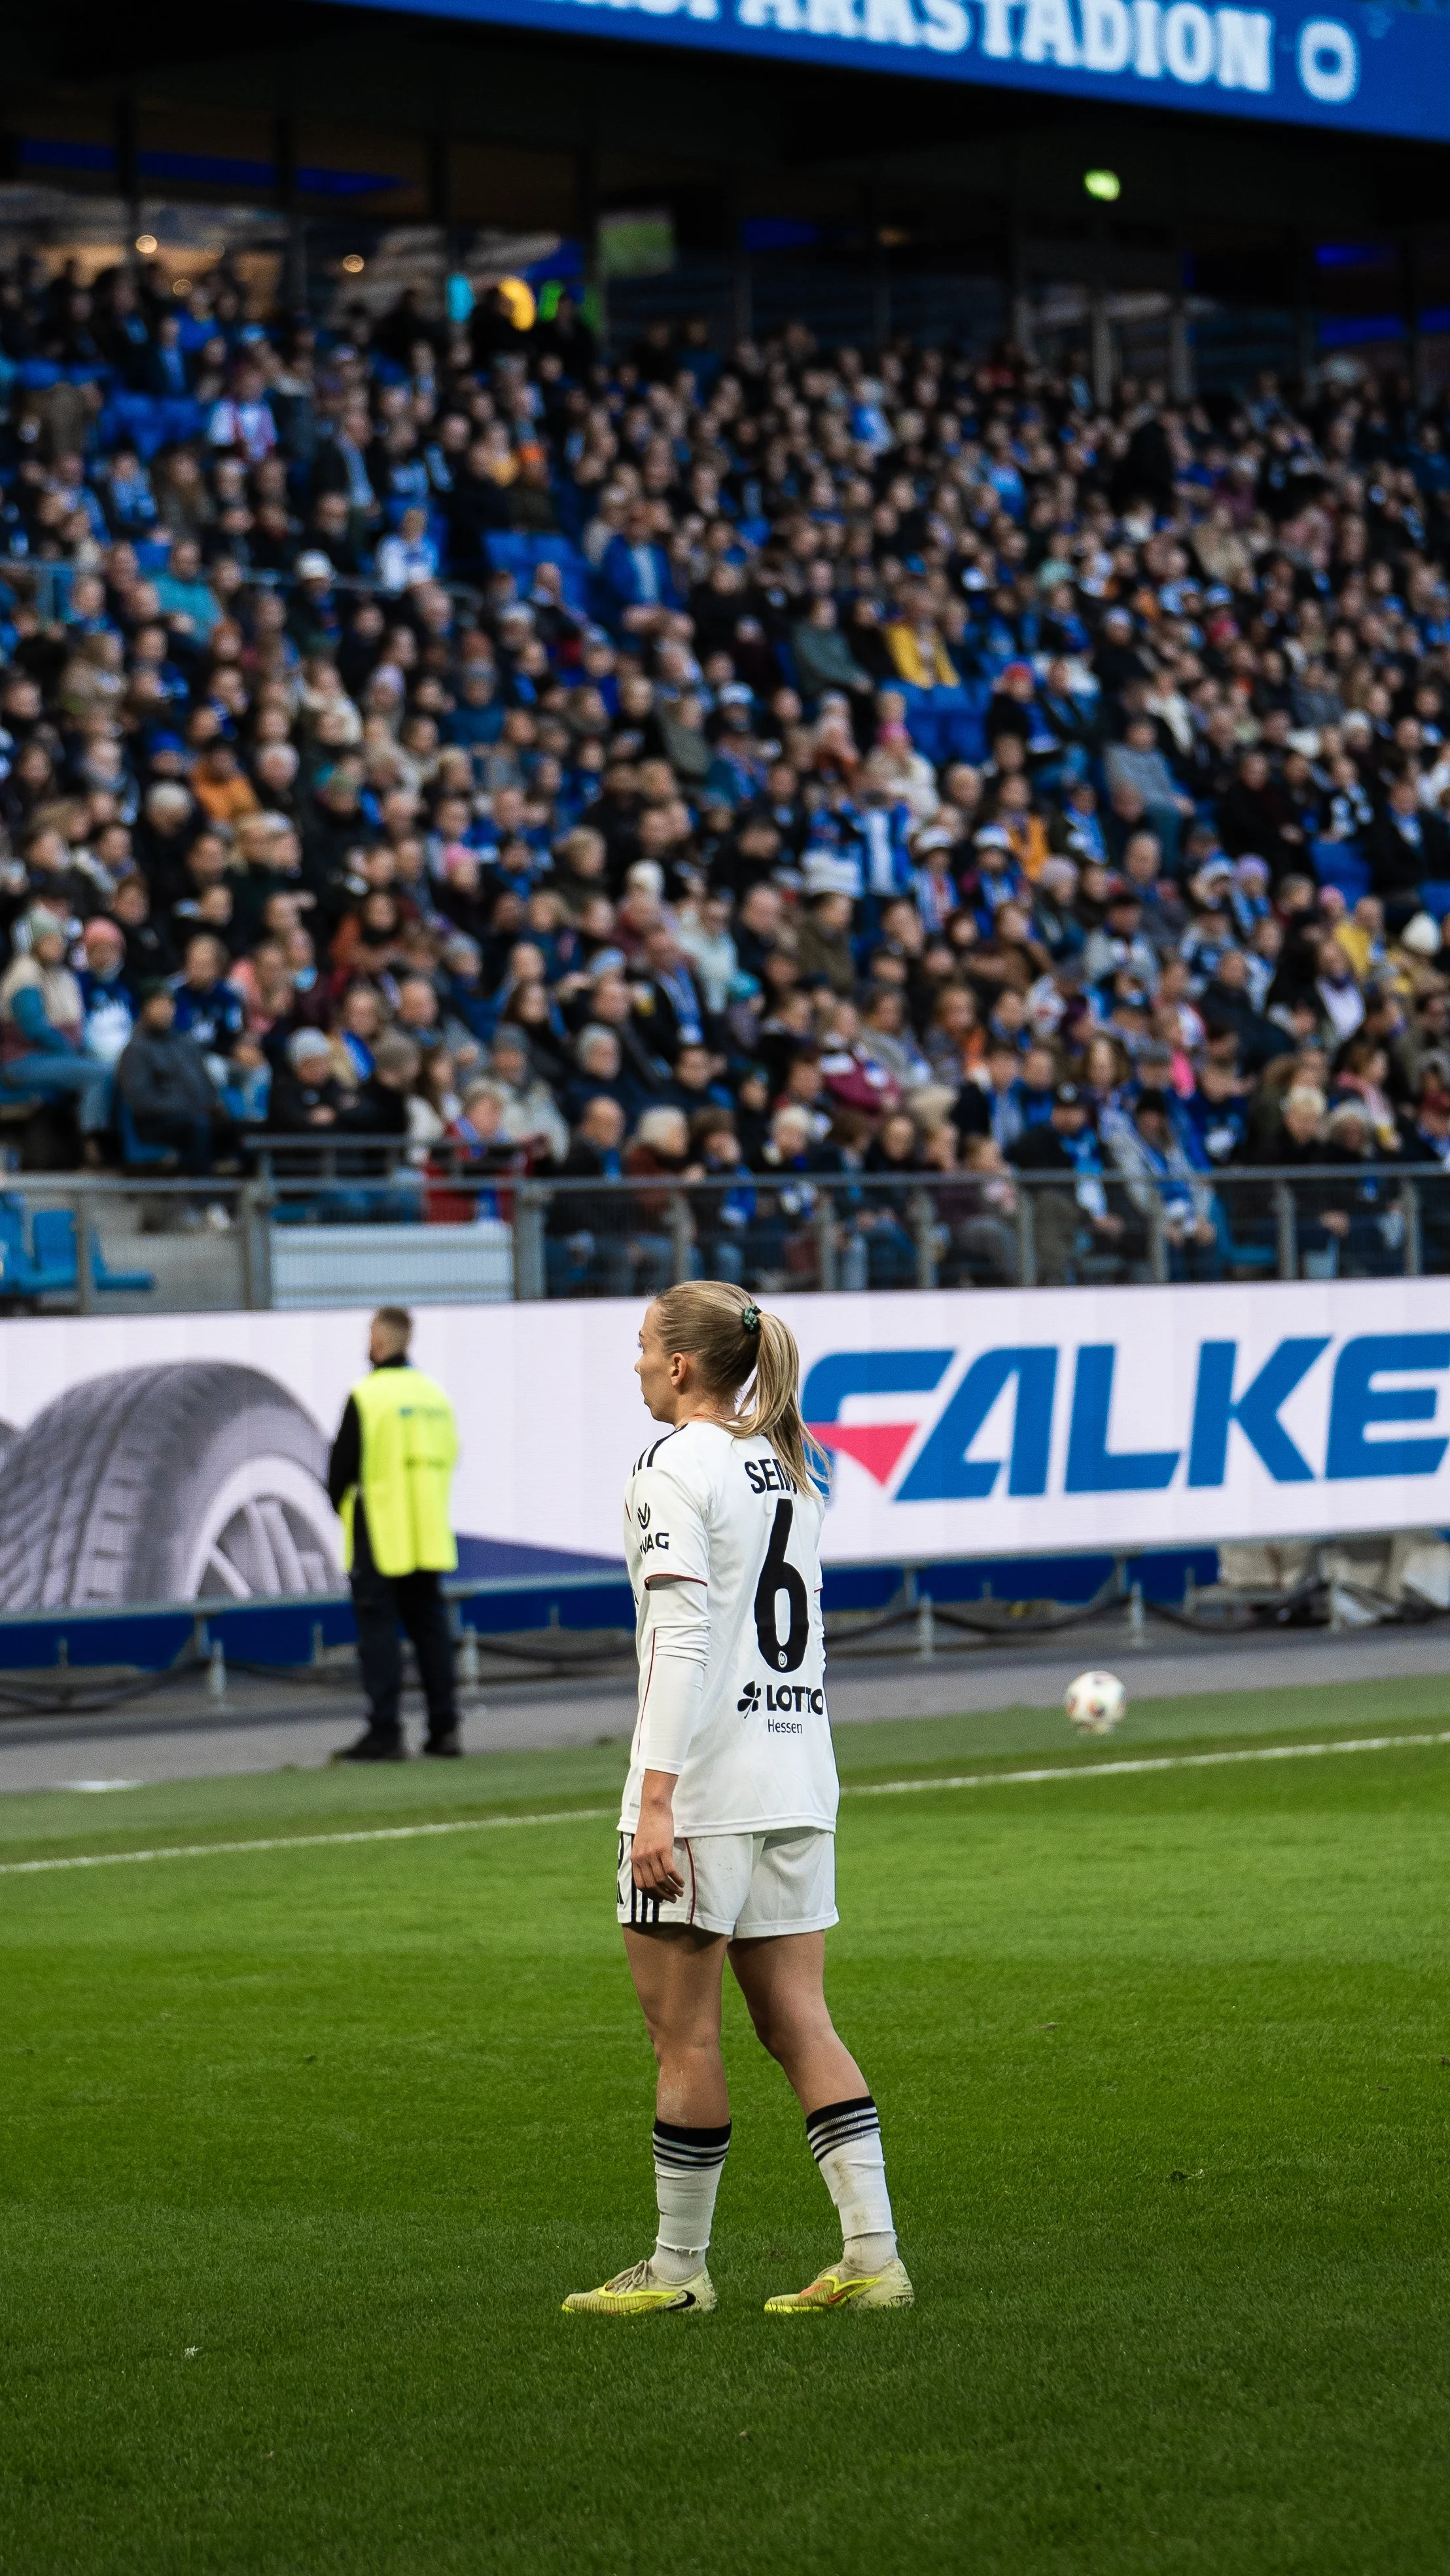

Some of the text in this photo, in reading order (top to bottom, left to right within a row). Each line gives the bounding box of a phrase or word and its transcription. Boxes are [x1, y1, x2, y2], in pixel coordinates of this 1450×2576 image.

[576, 0, 1273, 94] KSTADION
[639, 1532, 669, 1555] VAG
[754, 1497, 809, 1673] 6
[766, 1685, 824, 1715] LOTTO
[768, 1719, 803, 1734] Hessen
